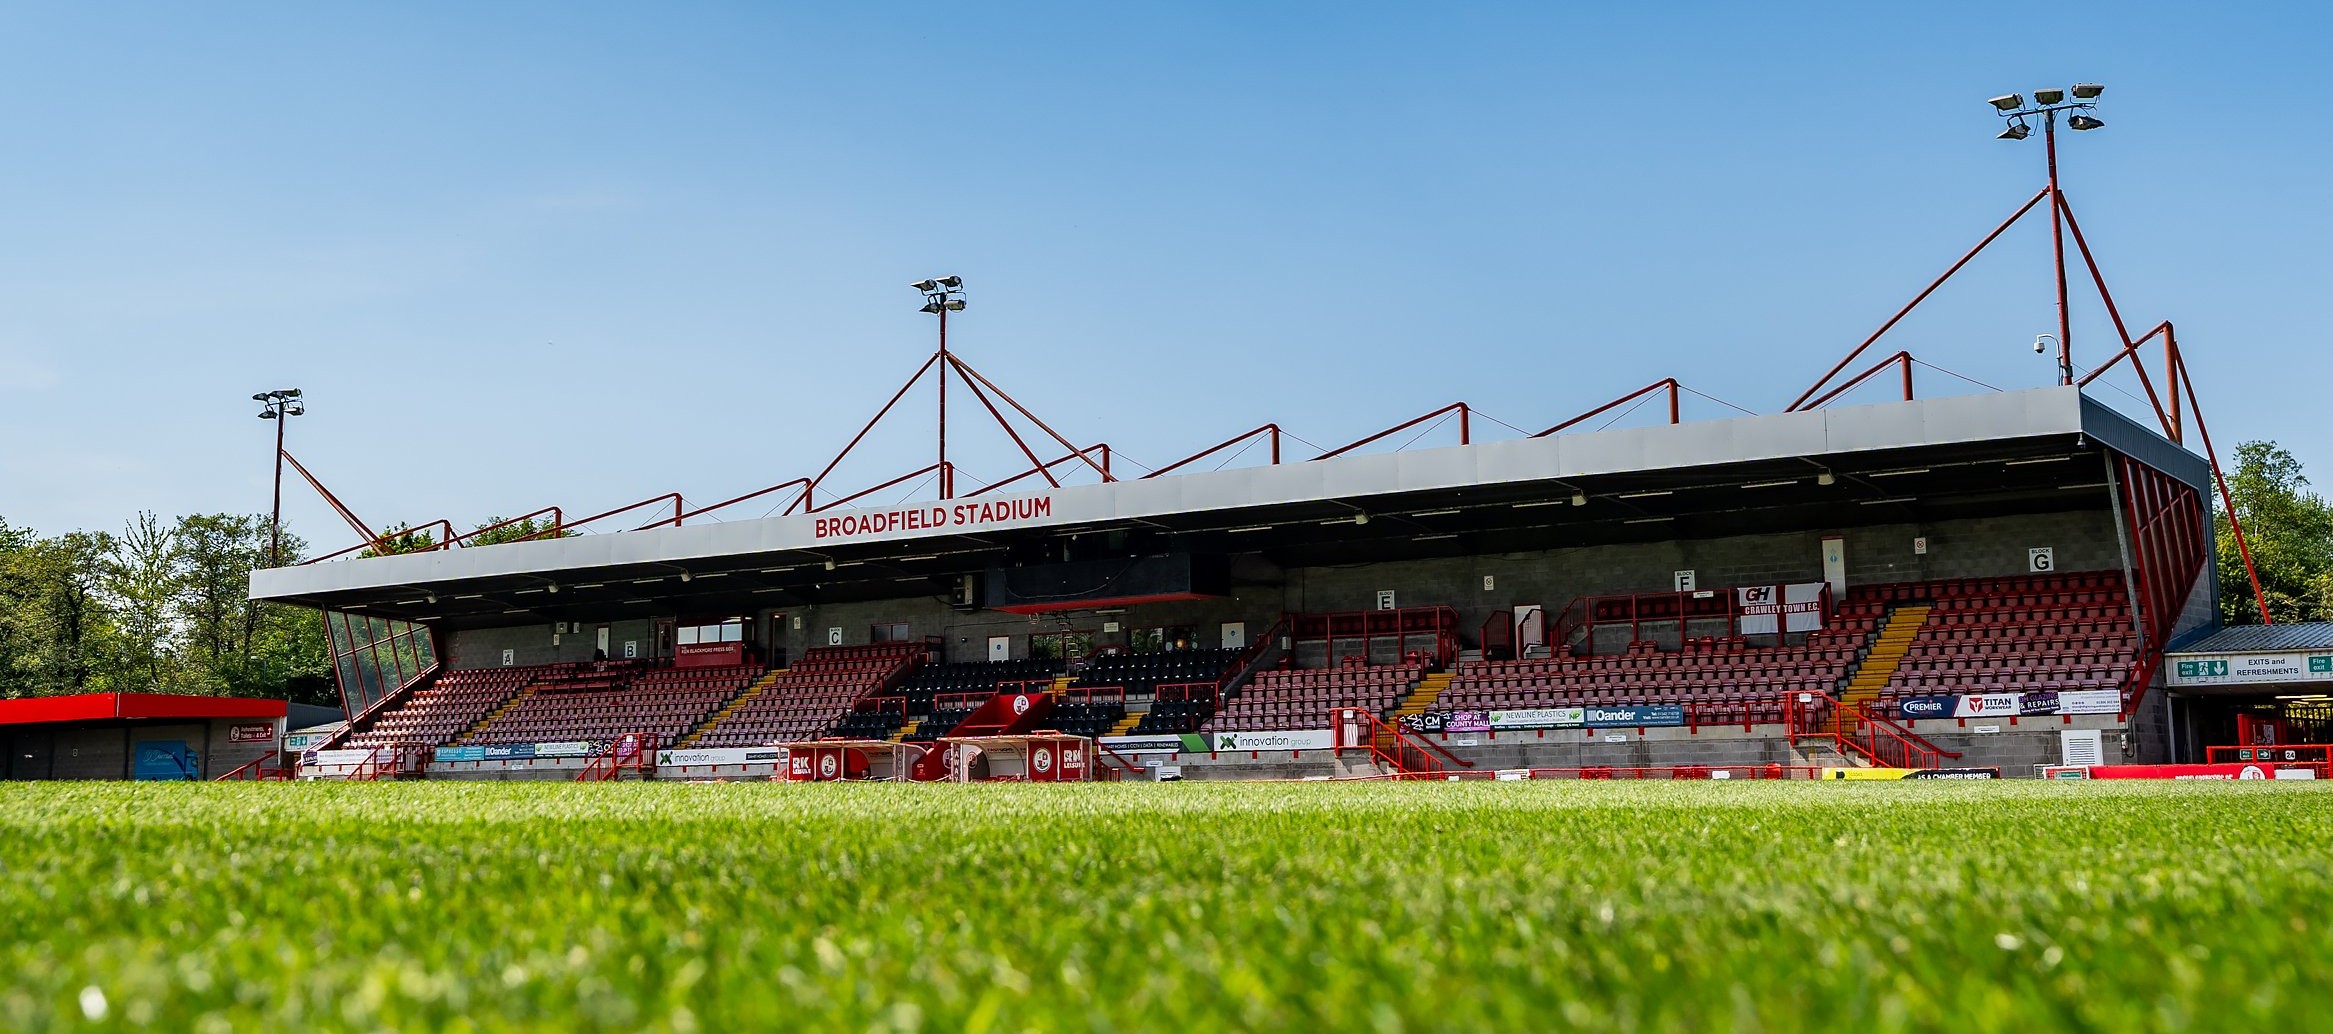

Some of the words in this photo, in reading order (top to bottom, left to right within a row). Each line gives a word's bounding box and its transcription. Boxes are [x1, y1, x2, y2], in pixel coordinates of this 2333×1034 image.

[815, 507, 947, 538] BROADFIELD
[953, 496, 1051, 525] STADIUM
[2034, 553, 2049, 570] G
[1679, 576, 1690, 592] F
[1745, 587, 1771, 602] GH
[1381, 596, 1391, 610] E
[1745, 605, 1780, 614] CRAWLEY
[1783, 603, 1806, 613] TOWN
[1807, 602, 1820, 611] F.C.
[831, 632, 839, 644] C
[627, 645, 634, 657] B
[504, 654, 512, 665] A
[2248, 658, 2270, 666] EXITS
[2236, 667, 2299, 676] REFRESHMENTS
[1984, 698, 2011, 706] TITAN
[2029, 693, 2058, 701] GLAZING
[1909, 702, 1942, 711] PREMIER
[2027, 699, 2060, 708] REPAIRS
[1425, 716, 1440, 726] CM
[1596, 709, 1636, 721] Oander
[1446, 720, 1473, 728] COUNTY
[1239, 735, 1289, 747] innovation
[1290, 738, 1311, 747] group
[489, 747, 512, 756] Oander
[1063, 749, 1081, 762] RK
[674, 753, 709, 763] innovation
[792, 756, 810, 769] RK
